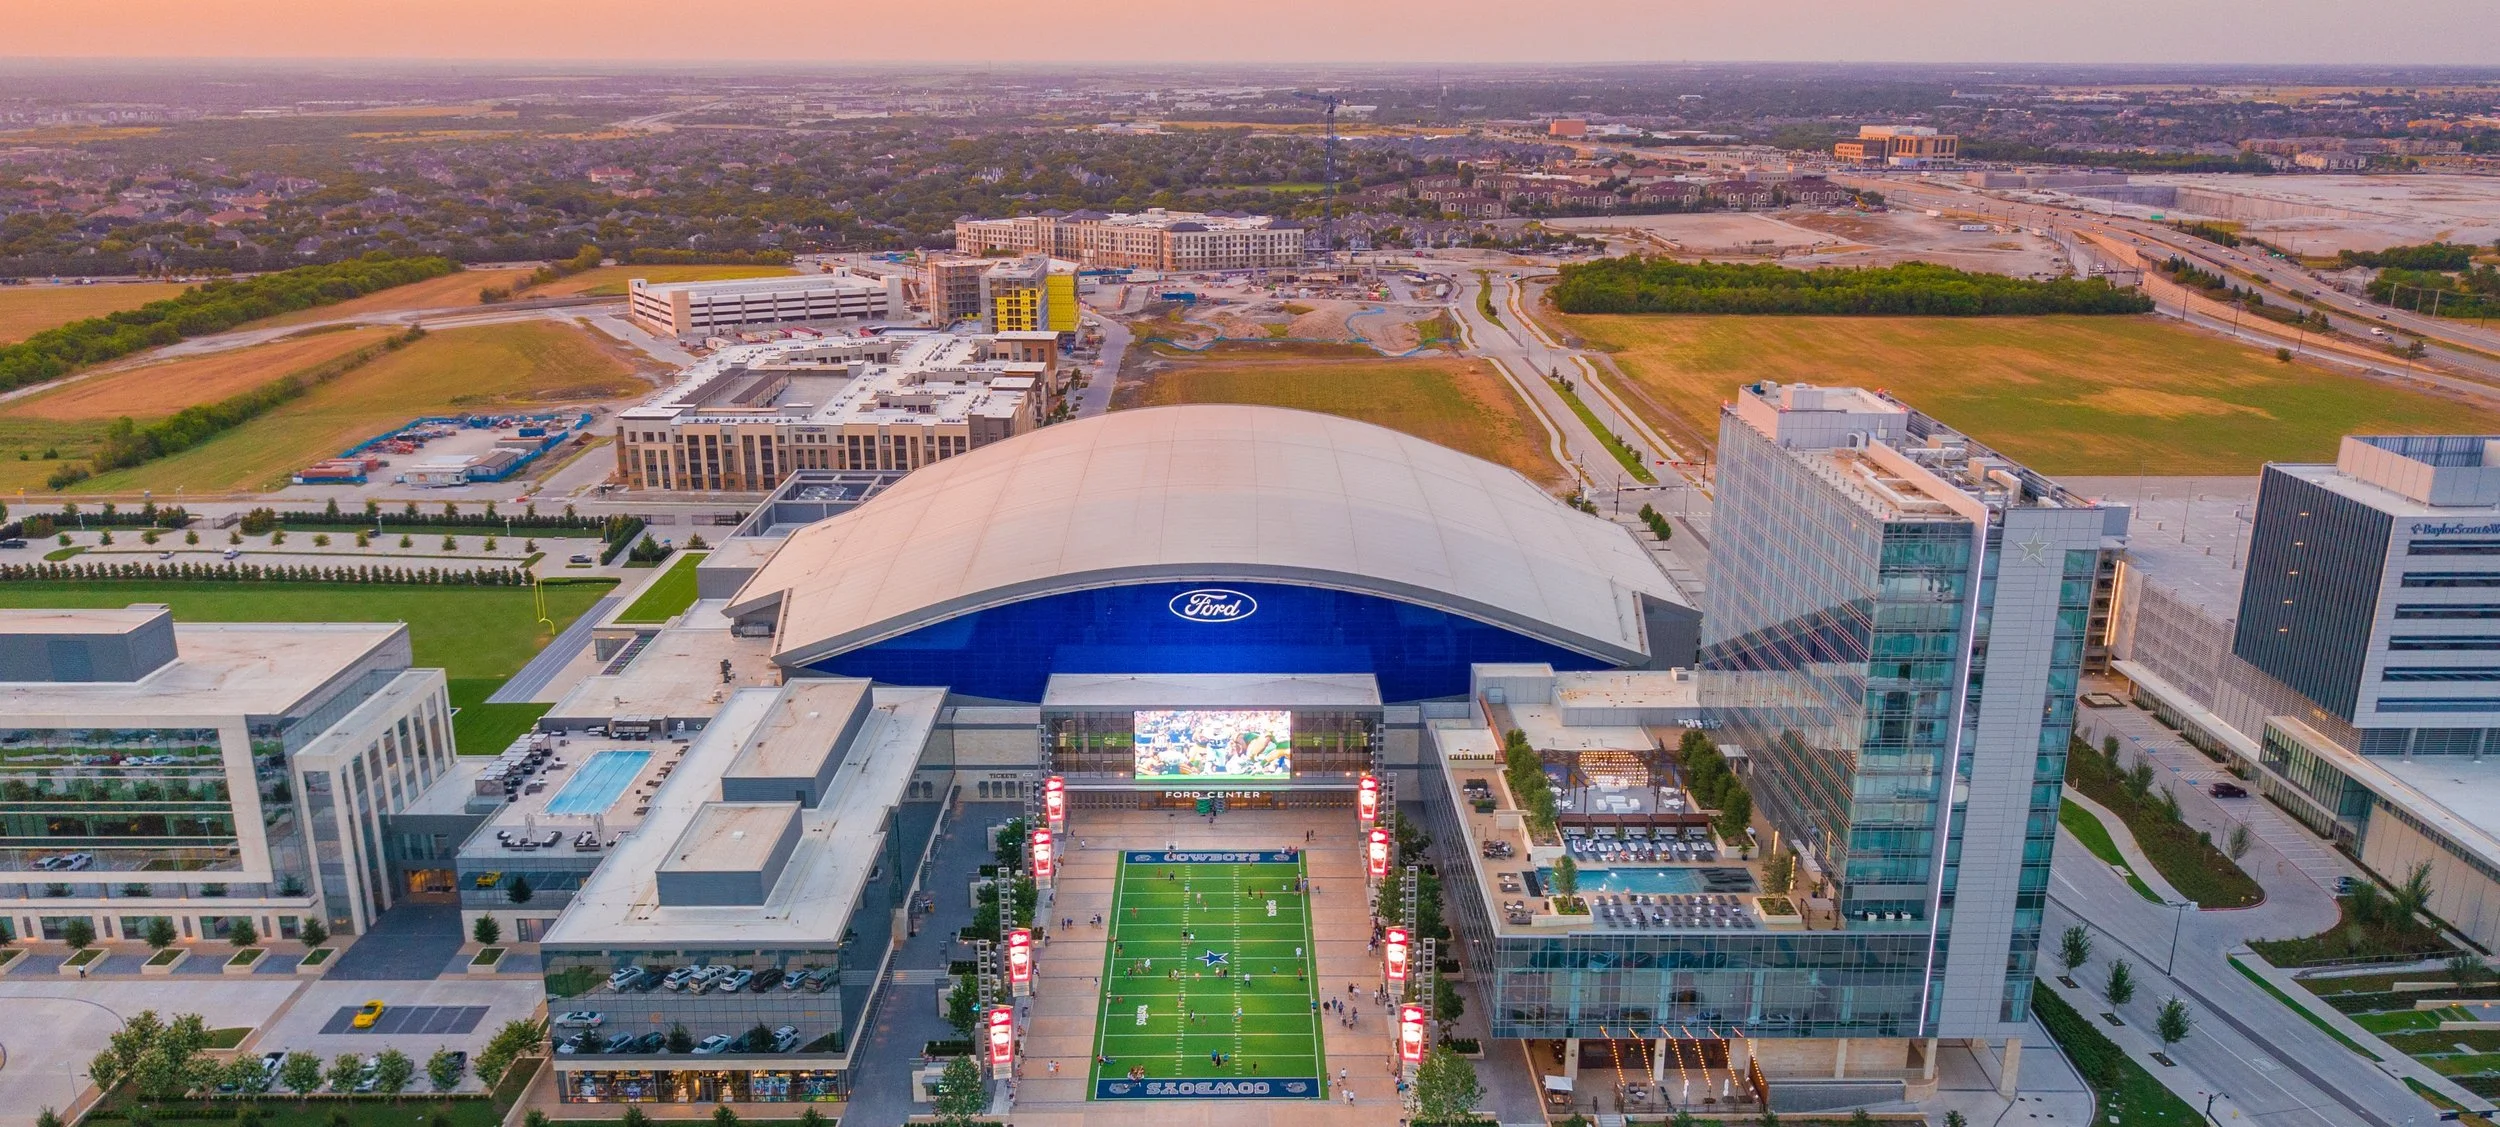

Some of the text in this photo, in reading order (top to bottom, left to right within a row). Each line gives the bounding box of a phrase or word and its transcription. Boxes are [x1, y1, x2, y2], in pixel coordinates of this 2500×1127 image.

[1184, 593, 1241, 616] Ford
[1165, 791, 1260, 799] FORD CENTER
[1164, 853, 1261, 862] COWBOYS
[1146, 1081, 1270, 1095] COWBOYS
